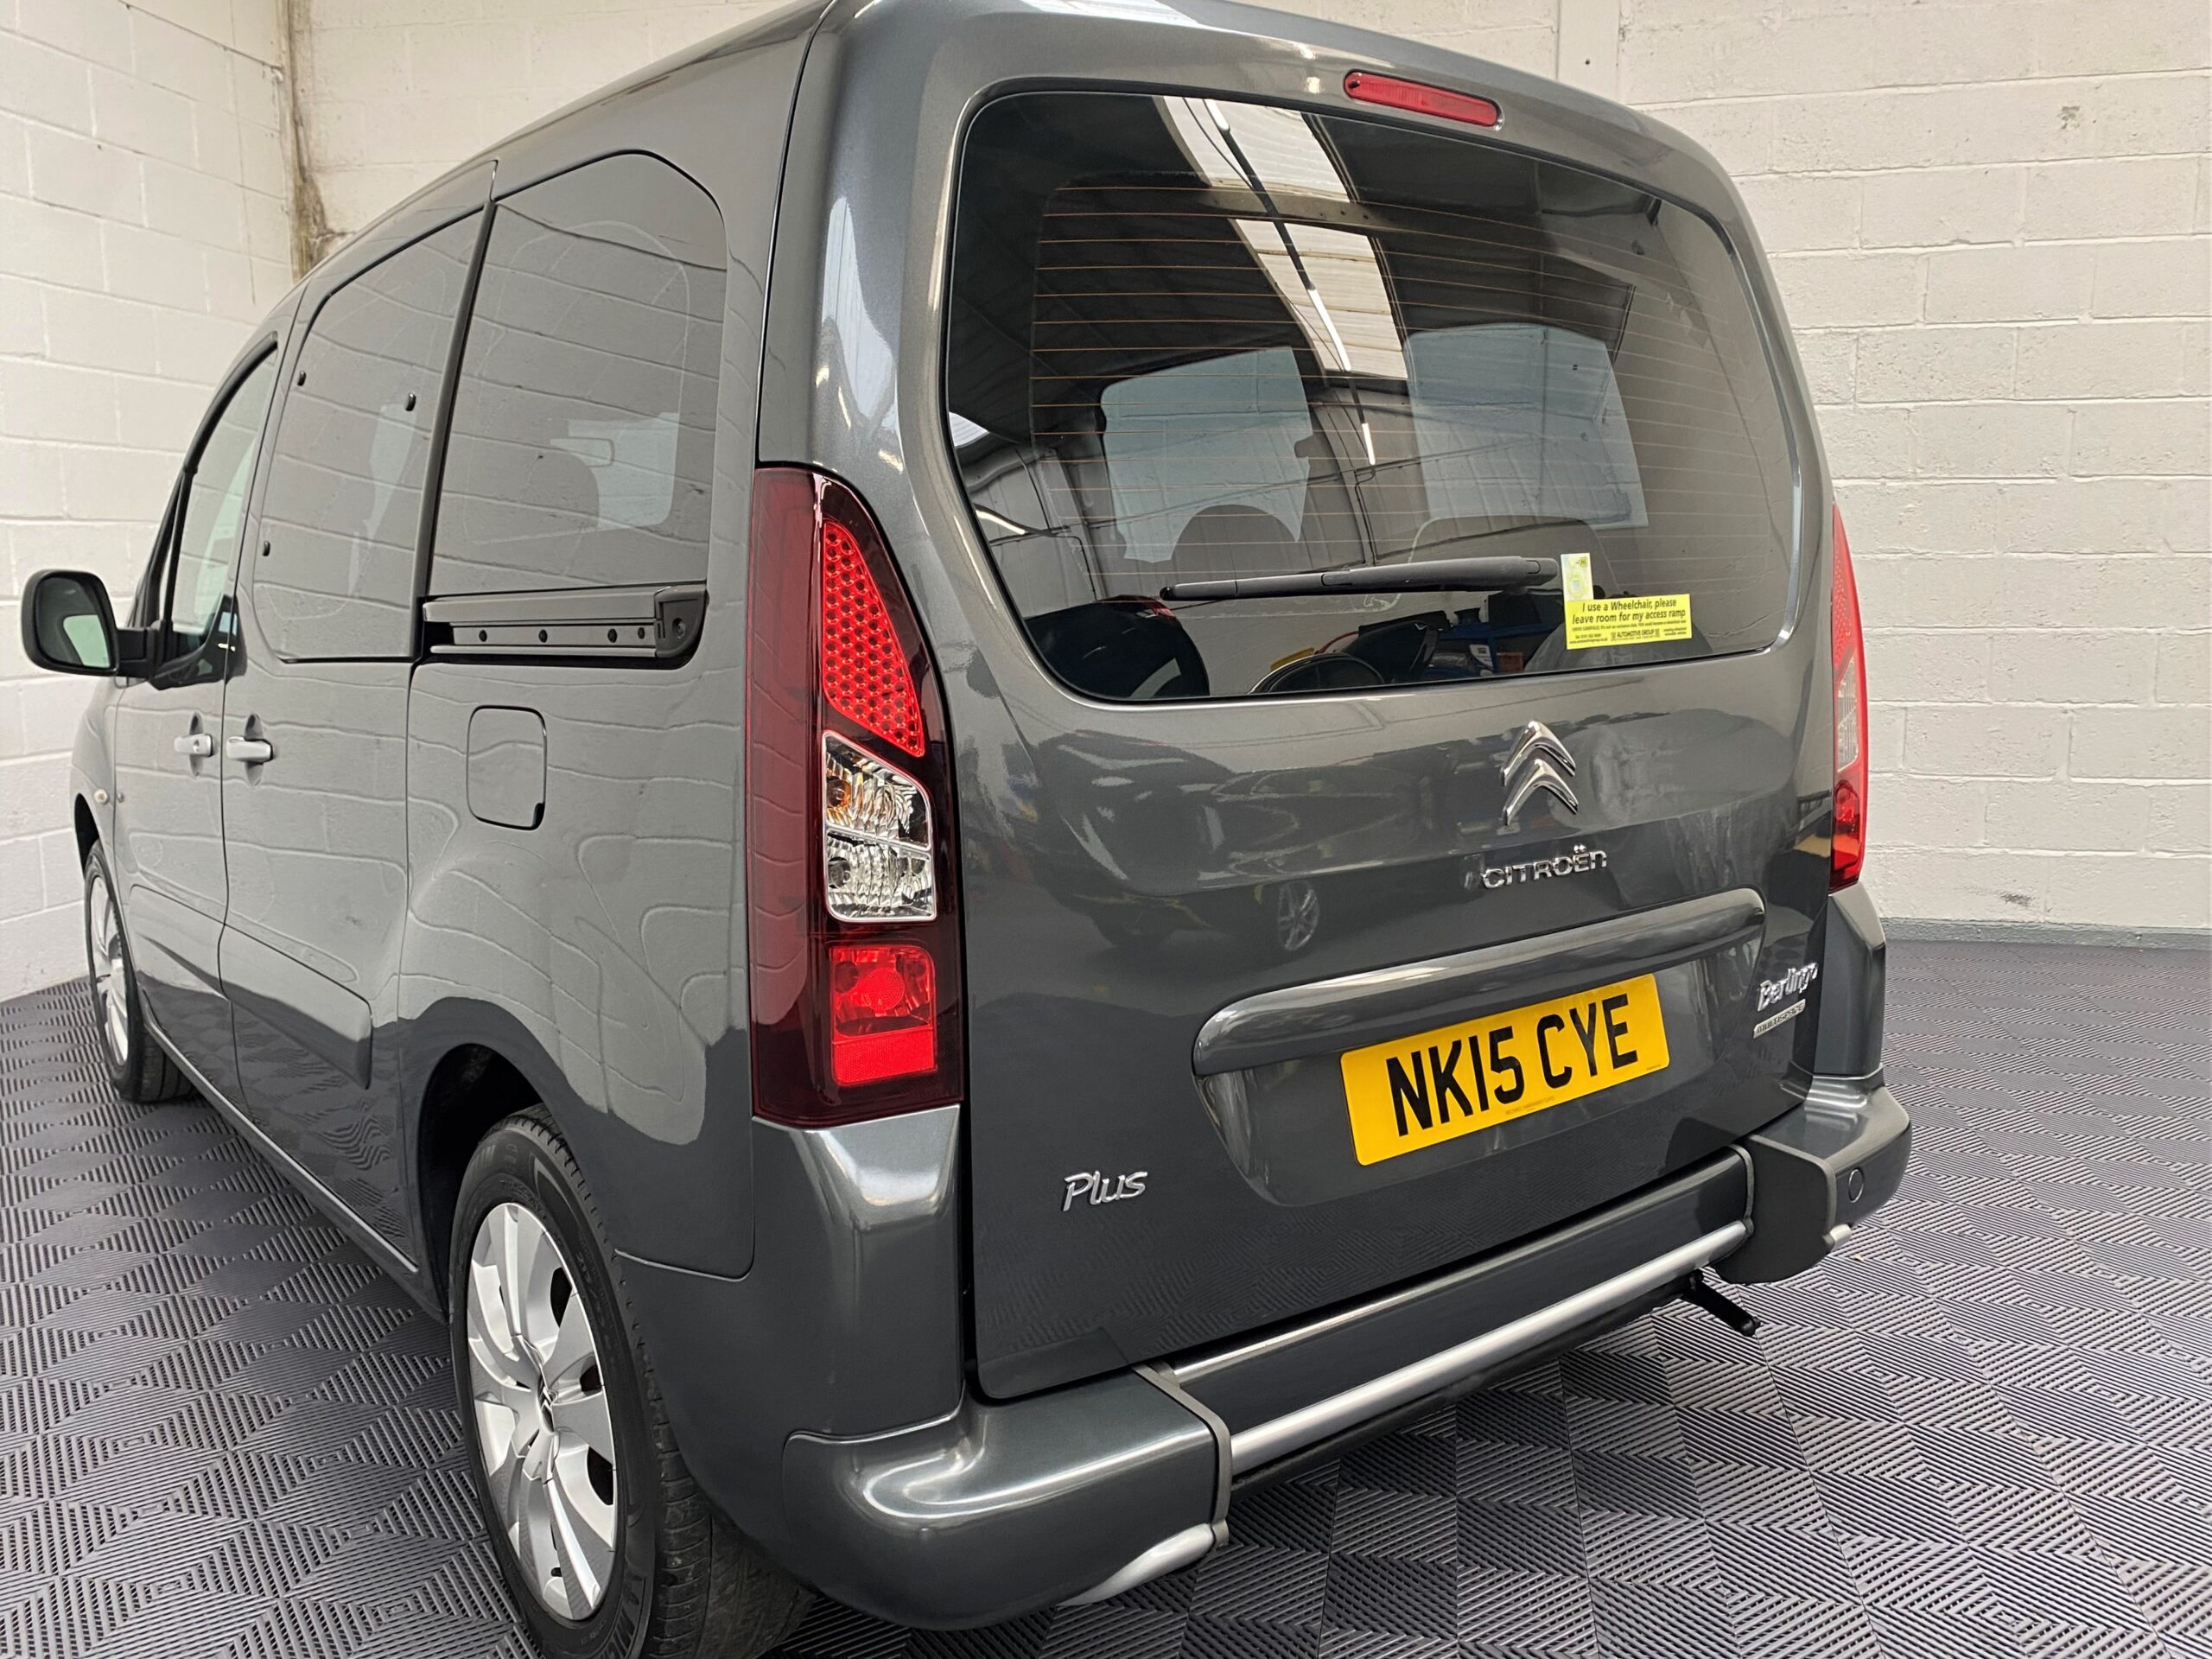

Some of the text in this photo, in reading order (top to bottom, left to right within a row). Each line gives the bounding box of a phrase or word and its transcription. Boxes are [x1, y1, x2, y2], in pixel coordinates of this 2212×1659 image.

[1572, 609, 1686, 625] leave room for my access ramp
[1582, 602, 1586, 613] I
[1603, 603, 1608, 612] a
[1611, 598, 1653, 611] Wheelchair,
[1655, 598, 1677, 611] please
[1385, 993, 1639, 1138] NK15 CYE
[1063, 1169, 1148, 1212] Plus
